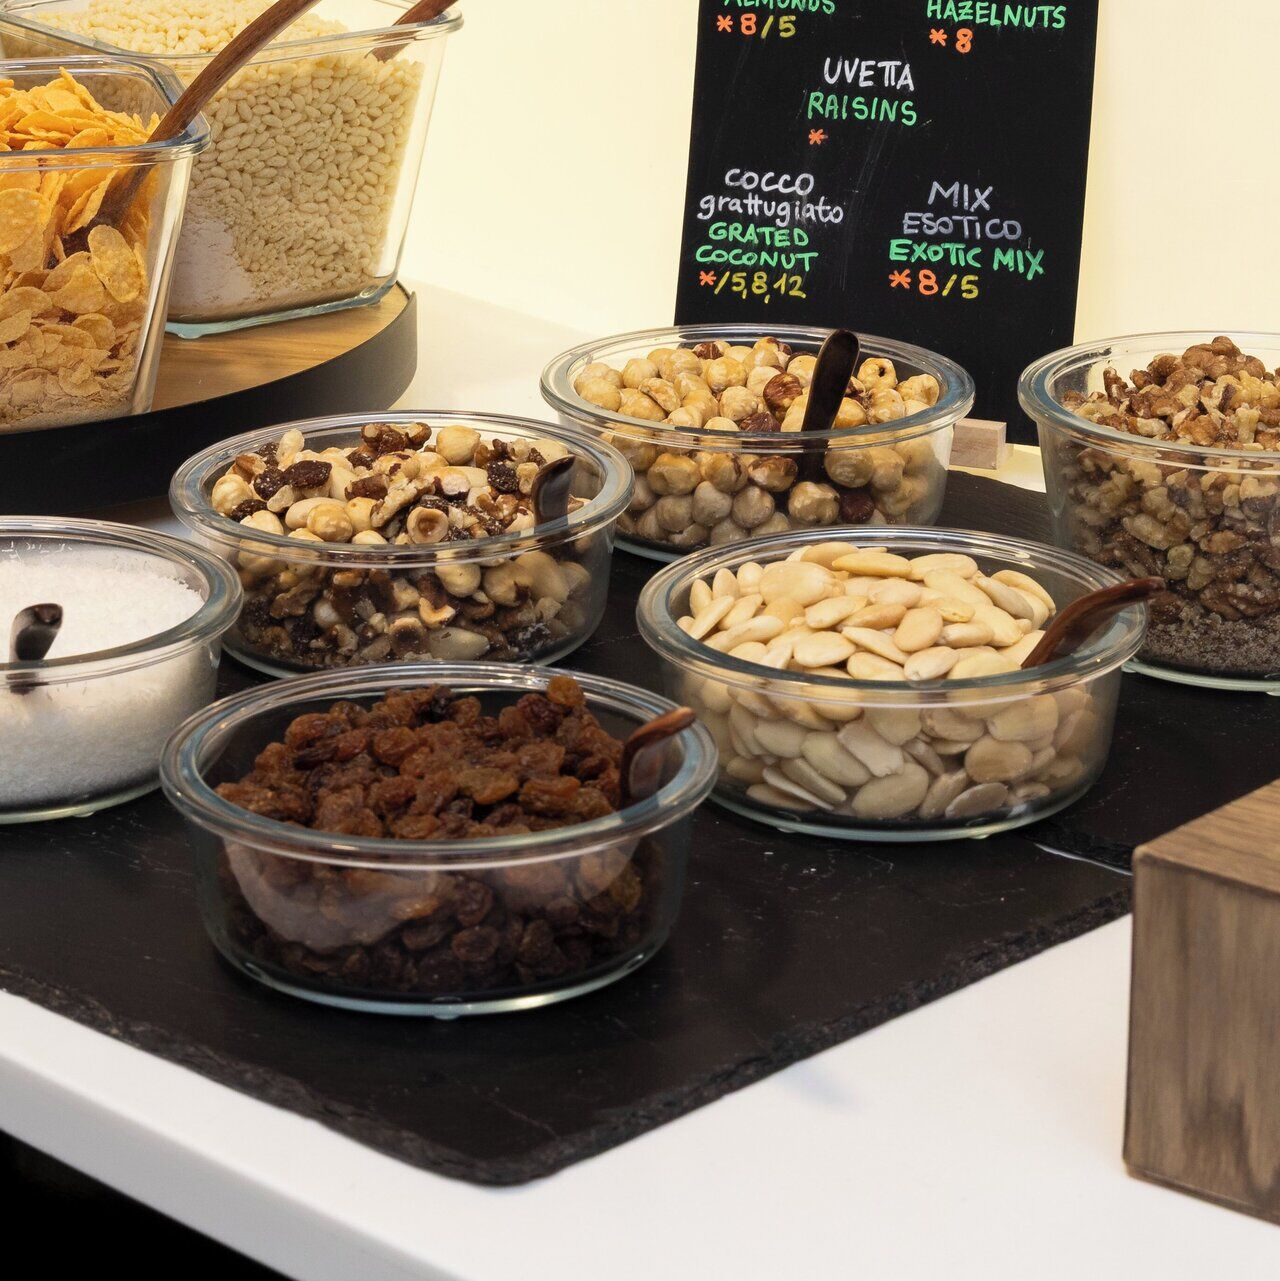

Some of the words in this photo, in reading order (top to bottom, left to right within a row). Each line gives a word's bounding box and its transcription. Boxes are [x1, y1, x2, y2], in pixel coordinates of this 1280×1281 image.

[824, 57, 915, 91] UVETTA
[807, 91, 917, 126] RAISINS
[724, 168, 815, 196] COCCO
[927, 180, 993, 212] MIX
[696, 193, 844, 227] grattugiato
[902, 212, 1021, 240] ESOTICO
[708, 221, 809, 247] GRATED
[695, 245, 818, 272] COCONUT
[889, 239, 982, 268] EXOTIC
[993, 247, 1045, 280] MIX
